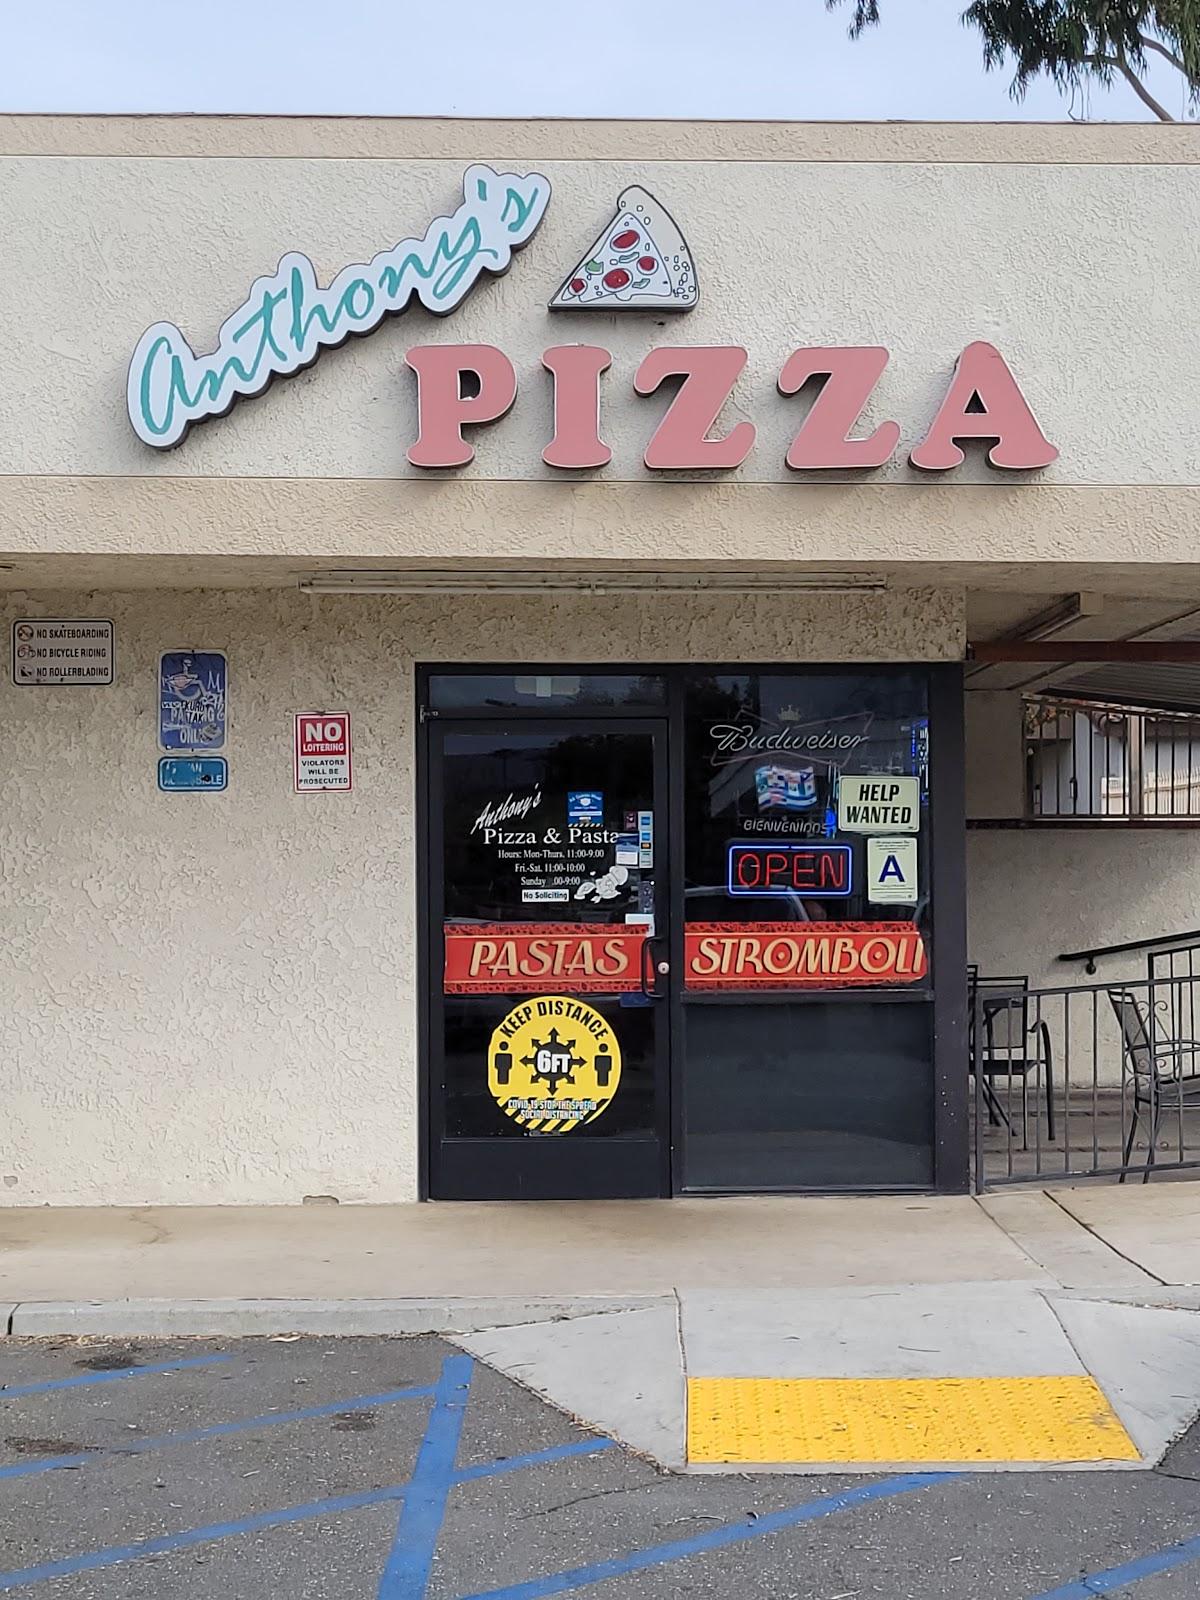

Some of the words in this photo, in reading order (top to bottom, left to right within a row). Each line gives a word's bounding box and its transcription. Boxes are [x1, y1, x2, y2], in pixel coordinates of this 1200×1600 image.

[140, 178, 539, 436] Anthony's
[404, 341, 1060, 470] PIZZA
[36, 629, 47, 639] NO
[49, 629, 109, 639] SKATEBOARDING
[36, 648, 47, 658] NO
[49, 648, 79, 658] BICYCLE
[80, 648, 107, 658] RIDING
[36, 667, 47, 677] NO
[49, 667, 109, 677] ROLLERBLADING
[305, 722, 342, 742] NO
[710, 724, 869, 752] Budweiser
[303, 743, 345, 753] LOITERING
[301, 759, 345, 767] VIOLATORS
[299, 777, 348, 785] PROSECUTED
[858, 784, 900, 802] HELP
[470, 782, 542, 835] Anthony's
[846, 806, 912, 824] WANTED
[483, 827, 538, 845] Pizza
[543, 827, 562, 844] &
[568, 827, 619, 844] Pasta
[498, 849, 522, 859] Hours:
[545, 863, 586, 873] 11:00-10:00
[737, 852, 844, 888] OPEN
[878, 855, 905, 883] A
[520, 876, 547, 888] Sunday
[524, 891, 533, 900] No
[535, 891, 568, 901] Soliciting
[469, 938, 630, 977] PASTAS
[691, 936, 925, 975] STROMBOLI
[499, 1006, 533, 1039] KEEP
[536, 1000, 609, 1041] DISTANCE
[537, 1050, 572, 1074] 6FT
[539, 1100, 556, 1111] STOP
[557, 1100, 570, 1111] THE
[571, 1100, 597, 1111] SPREAD
[520, 1109, 543, 1120] SOCIAL
[544, 1109, 585, 1121] DISTANCING
